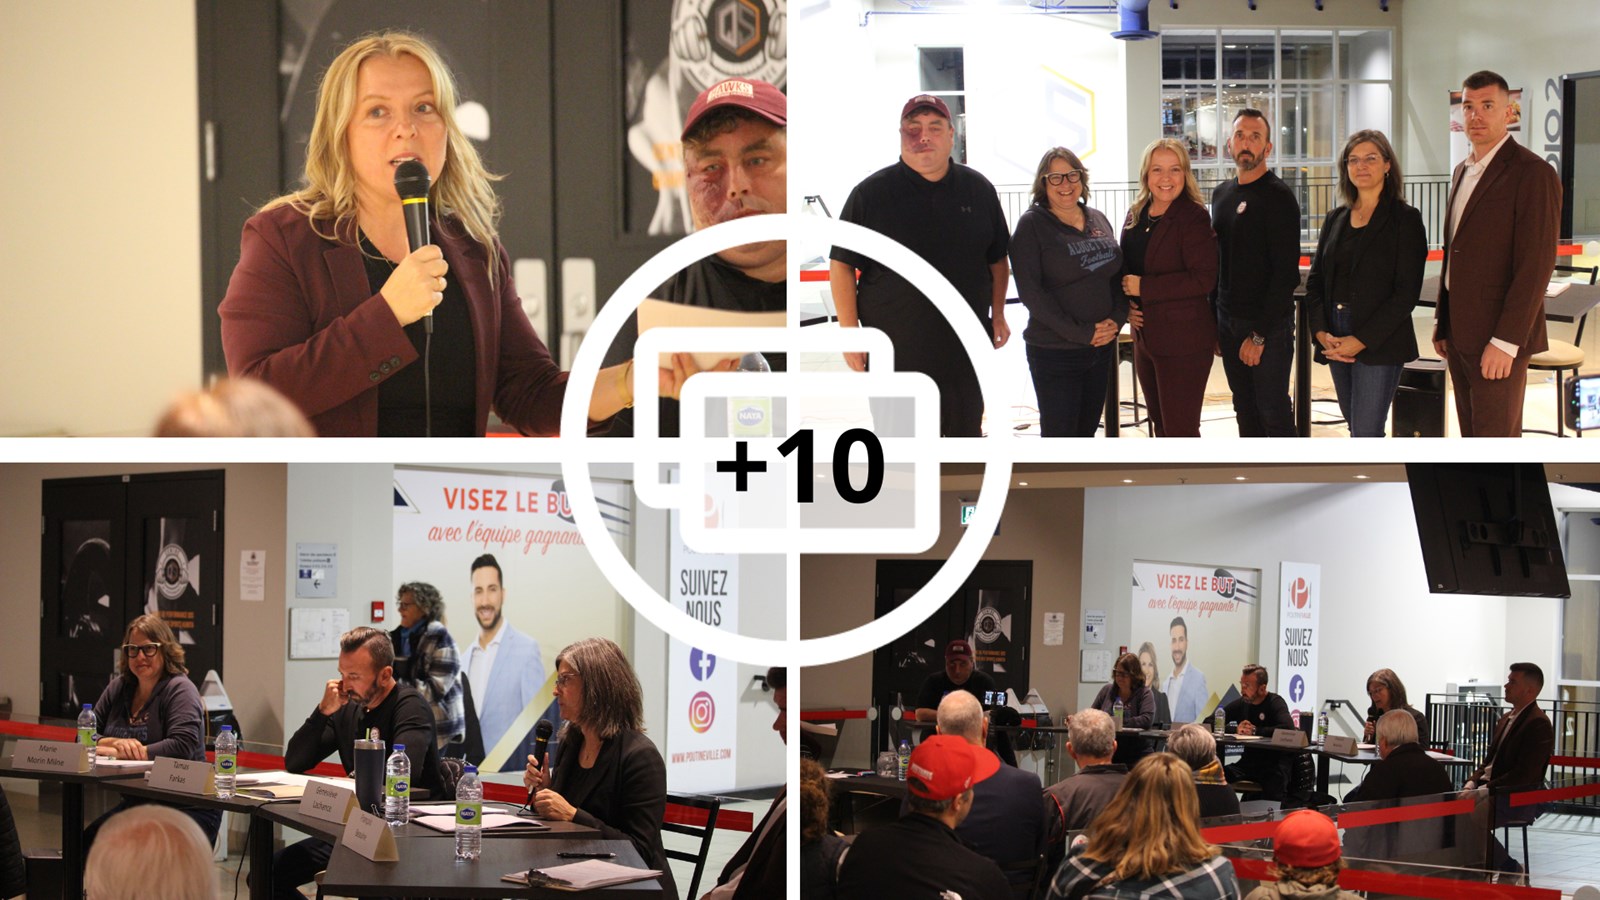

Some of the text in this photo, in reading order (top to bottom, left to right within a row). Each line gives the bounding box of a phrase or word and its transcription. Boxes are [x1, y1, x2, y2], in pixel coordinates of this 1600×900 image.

[443, 487, 572, 515] VISEZ LE BU
[428, 520, 586, 556] avec l'équipe gagnan
[680, 569, 728, 596] SUIVEZ
[1157, 574, 1234, 593] VISEZ LE BUT
[686, 600, 722, 627] NOUS
[1148, 598, 1166, 609] avec
[1168, 594, 1198, 613] l'équipe
[1198, 599, 1234, 618] gagnante
[1285, 627, 1313, 646] SUIVEZ
[1287, 648, 1309, 667] NOUS
[39, 745, 58, 753] Marie
[671, 748, 732, 764] WWW.POUTINEVILLE.COM
[27, 756, 46, 764] Morin
[173, 761, 190, 770] Tamas
[169, 774, 186, 784] Farkas
